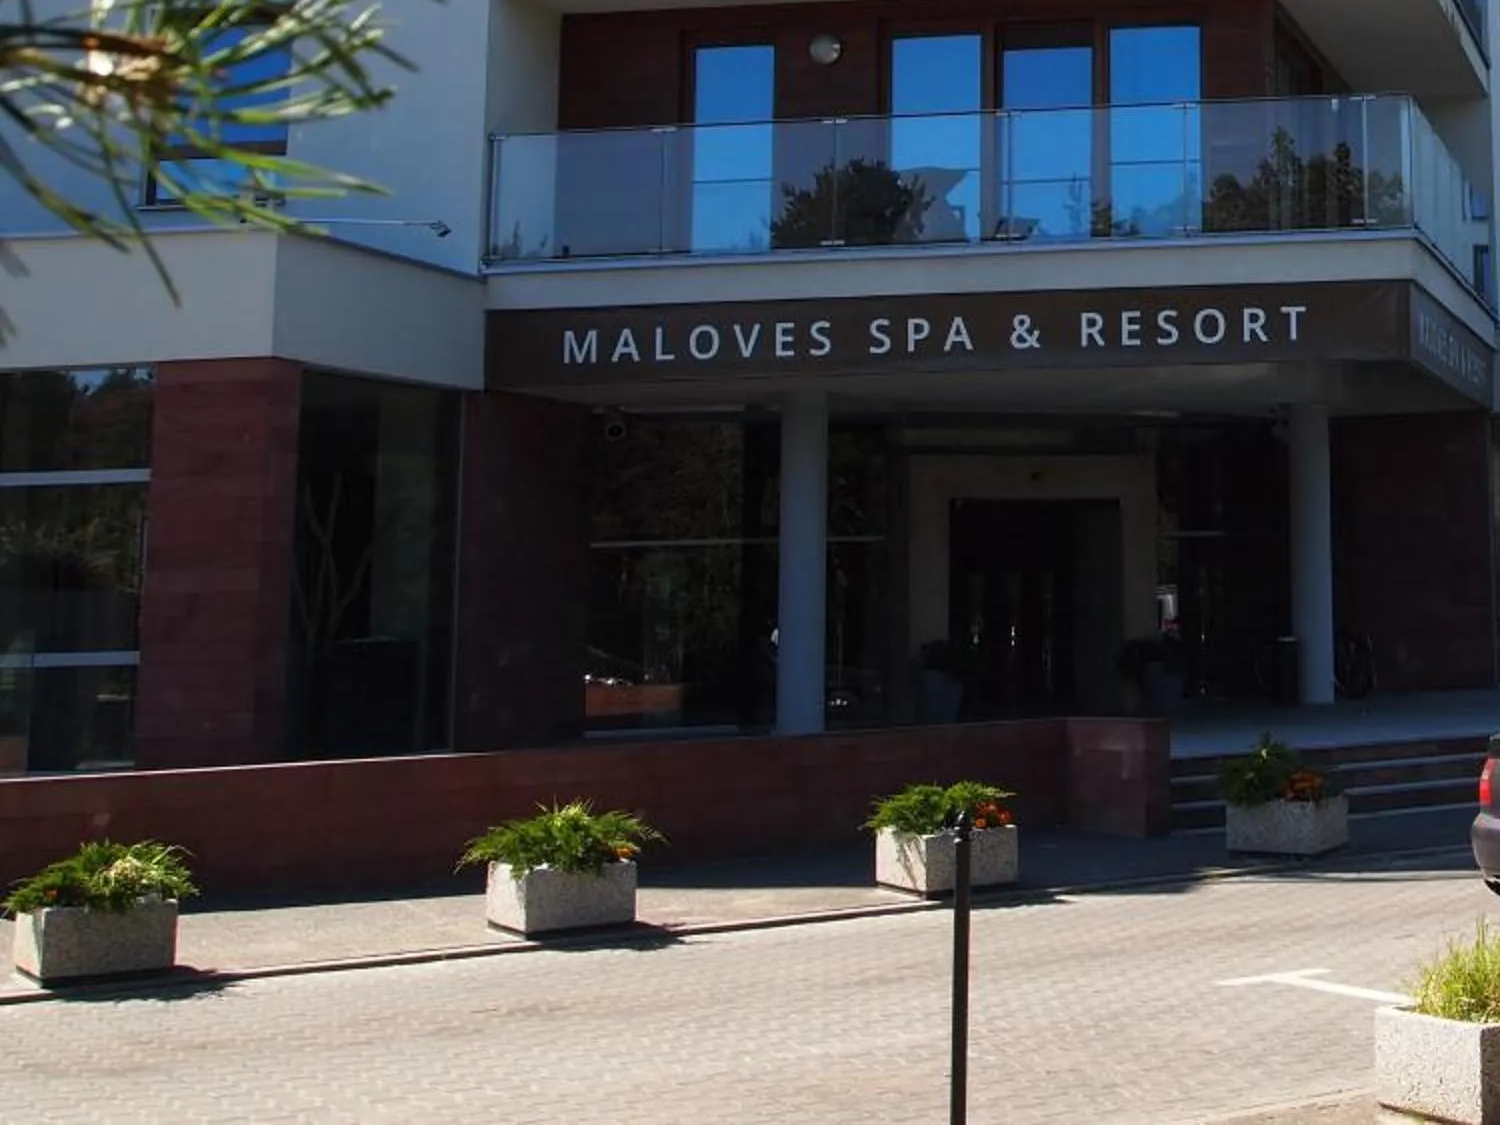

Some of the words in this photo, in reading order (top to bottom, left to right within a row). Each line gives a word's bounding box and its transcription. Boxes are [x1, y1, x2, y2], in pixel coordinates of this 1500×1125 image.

[563, 319, 832, 364] MALOVES
[869, 316, 974, 354] SPA
[1010, 314, 1041, 349] &
[1080, 306, 1307, 348] RESORT
